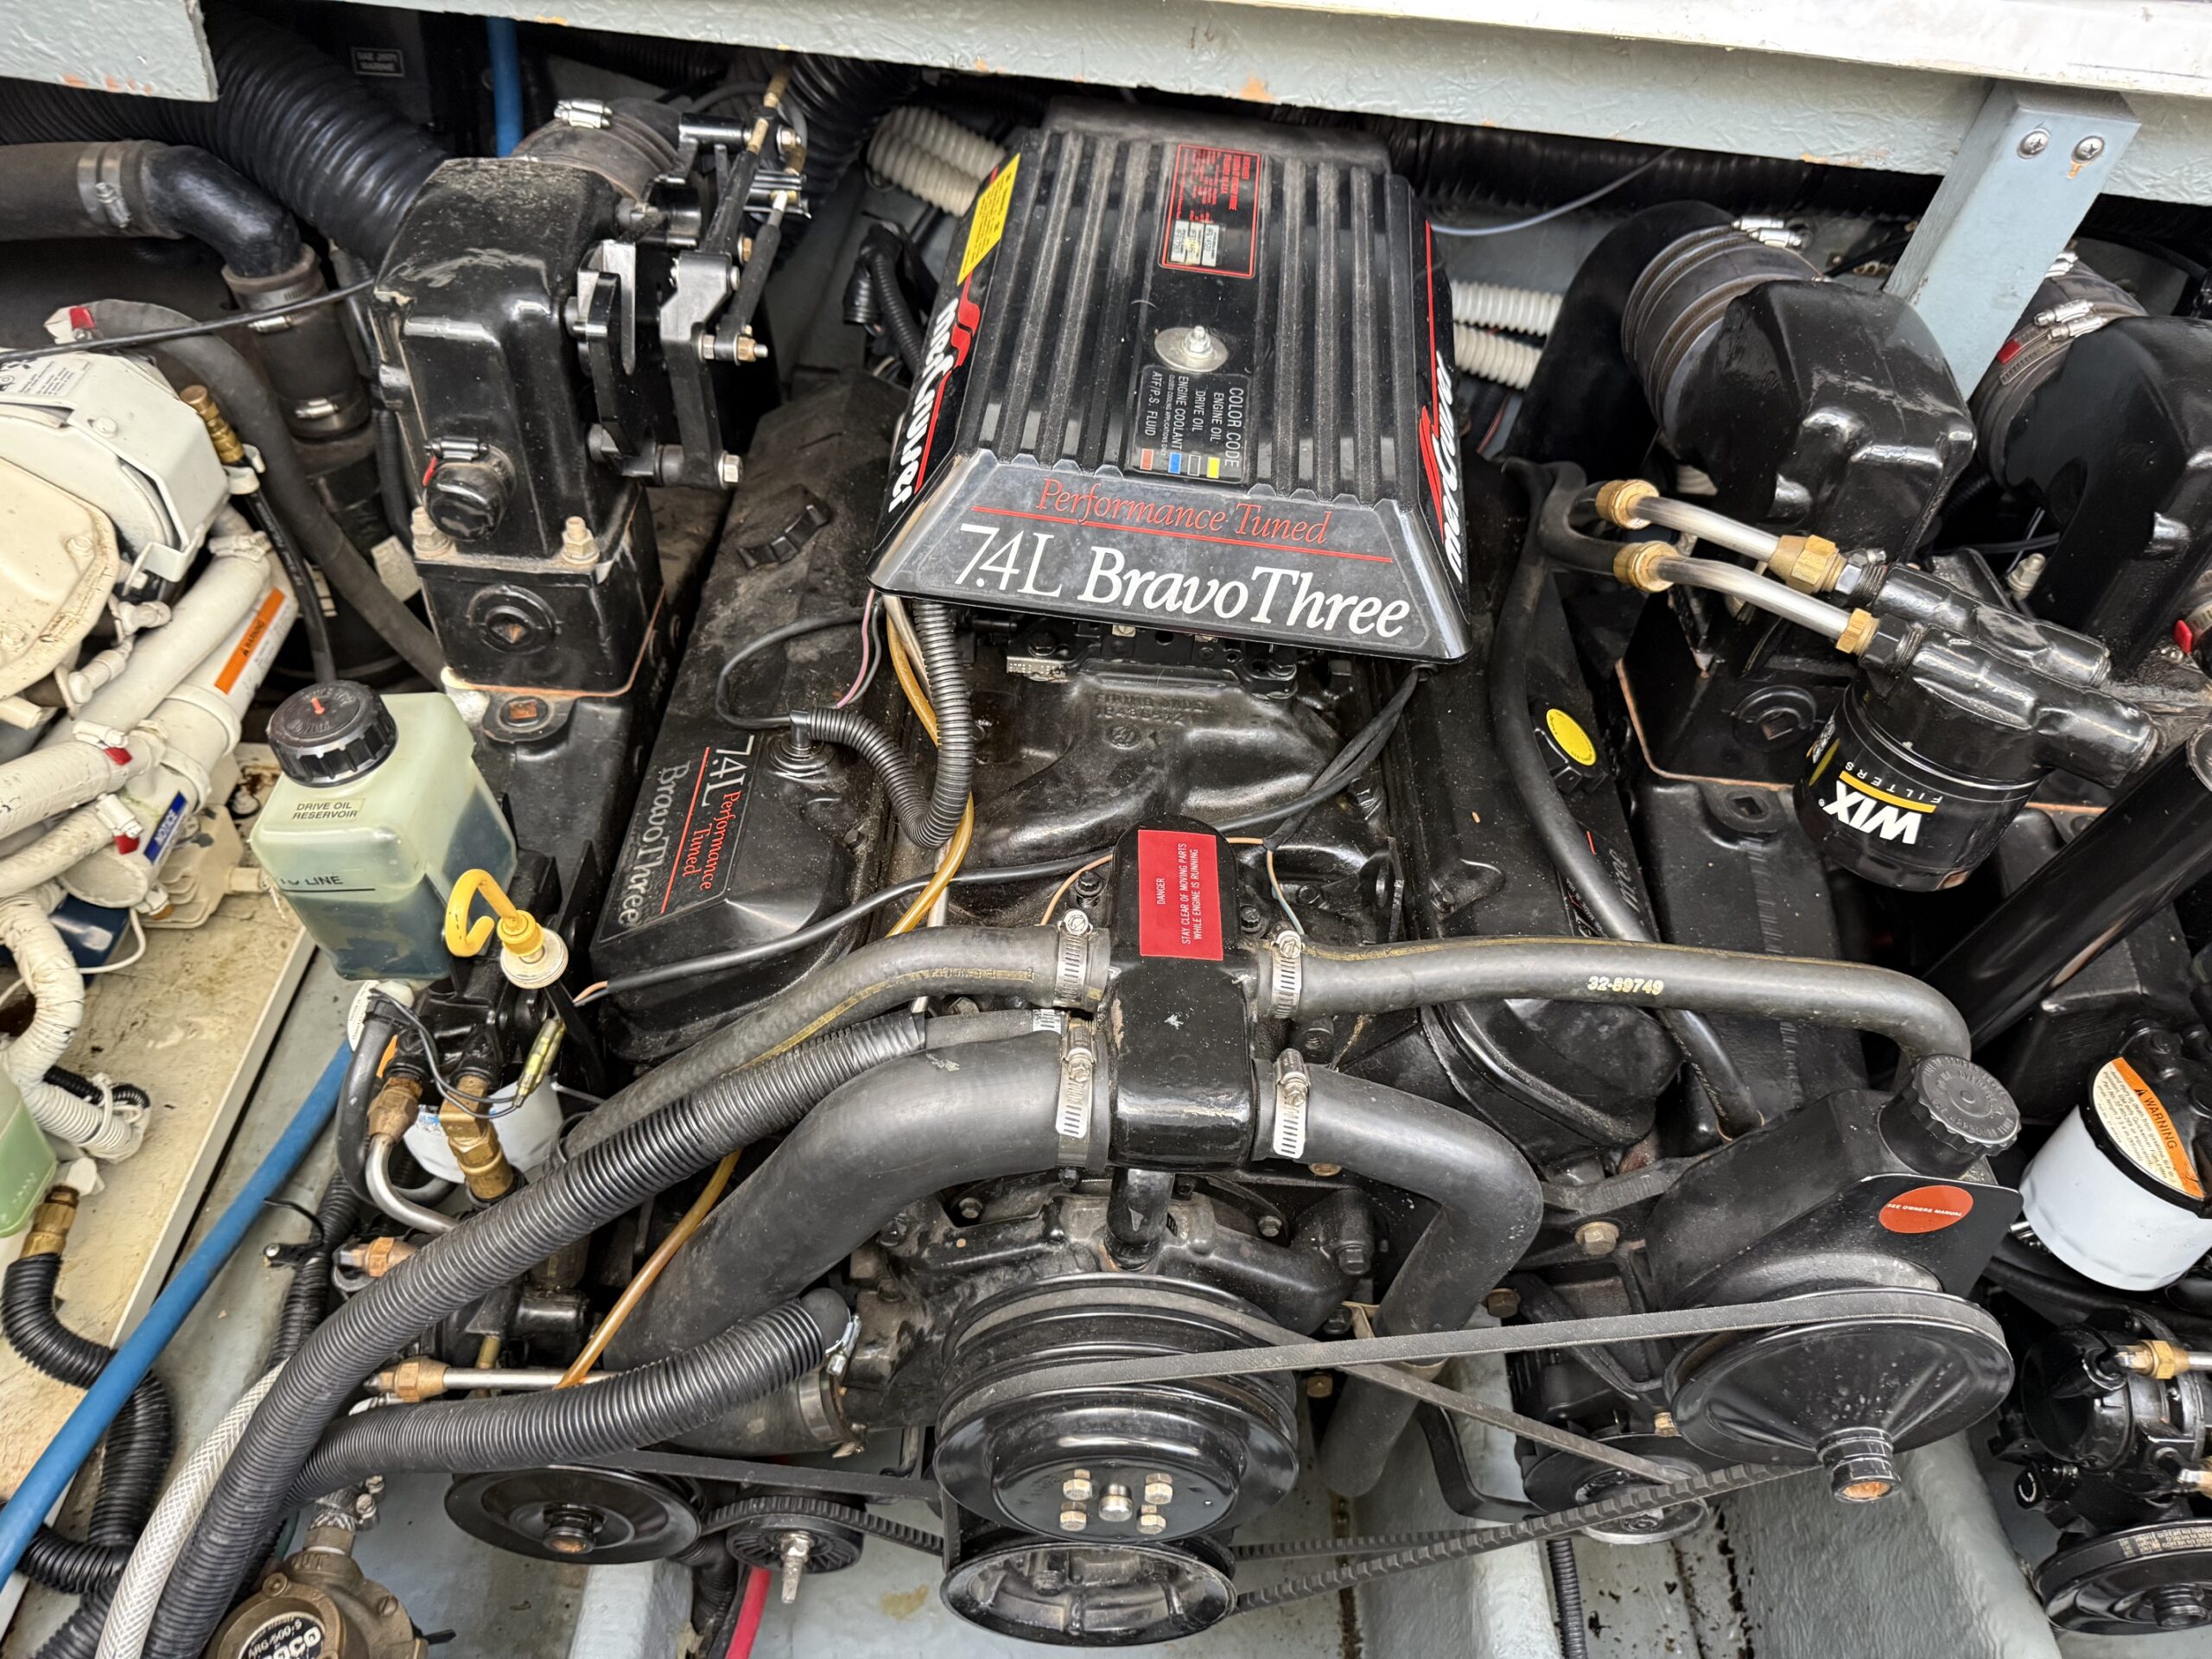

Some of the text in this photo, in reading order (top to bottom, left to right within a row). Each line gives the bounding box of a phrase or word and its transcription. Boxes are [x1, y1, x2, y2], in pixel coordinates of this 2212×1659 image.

[1146, 410, 1158, 436] FLUID
[1173, 376, 1189, 449] ENGINE COOLANT
[1192, 391, 1206, 432] DRIVE OIL
[1211, 392, 1224, 442] ENGINE OIL
[1224, 387, 1244, 467] COLOR CODE
[1035, 478, 1332, 543] Performance Tuned
[955, 523, 1063, 598] 7.4L
[1845, 761, 1943, 804] FILTERS
[292, 810, 359, 820] RESERVOIR
[699, 735, 755, 891] 7.4L Performance
[1822, 779, 1922, 844] WIX
[682, 823, 713, 878] Tuned
[1178, 843, 1187, 863] PARTS
[1190, 849, 1199, 880] RUNNING
[305, 875, 344, 886] LINE
[1156, 878, 1166, 905] DANGER
[1179, 866, 1188, 891] MOVING
[1180, 904, 1190, 925] CLEAR
[1192, 891, 1201, 915] ENGINE
[1181, 927, 1191, 944] STAY
[1192, 918, 1202, 939] WHILE
[1586, 976, 1664, 995] 32-89749
[2132, 1103, 2145, 1117] death
[2141, 1117, 2152, 1131] from
[2145, 1097, 2177, 1149] WARNING
[1903, 1205, 1933, 1213] OWNERS
